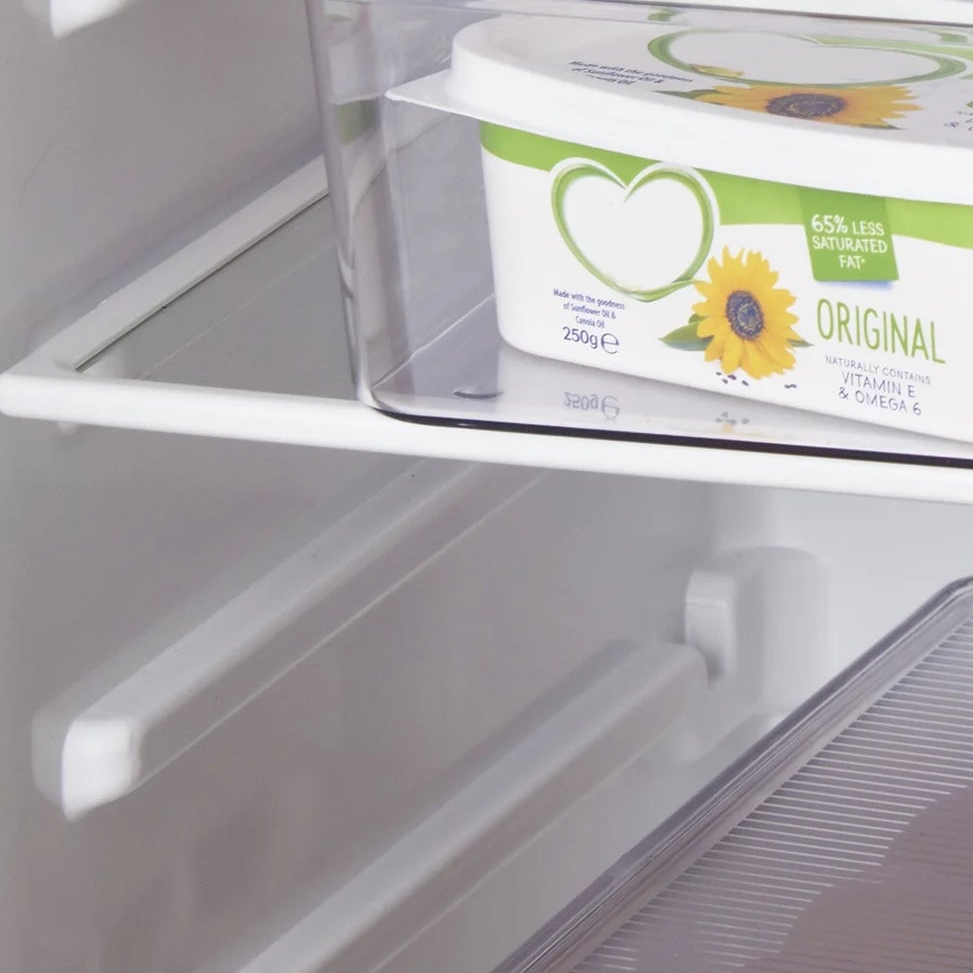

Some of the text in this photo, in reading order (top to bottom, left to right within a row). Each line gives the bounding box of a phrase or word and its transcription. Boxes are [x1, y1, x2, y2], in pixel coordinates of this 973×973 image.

[811, 213, 885, 237] 65% LESS
[811, 235, 888, 254] SATURATED
[571, 292, 585, 302] with
[562, 326, 598, 349] 250g
[817, 298, 946, 364] ORIGINAL
[825, 354, 931, 385] NATURALLY CONTAINS
[842, 370, 916, 399] VITAMIN E
[838, 386, 922, 416] & OMEGA 6
